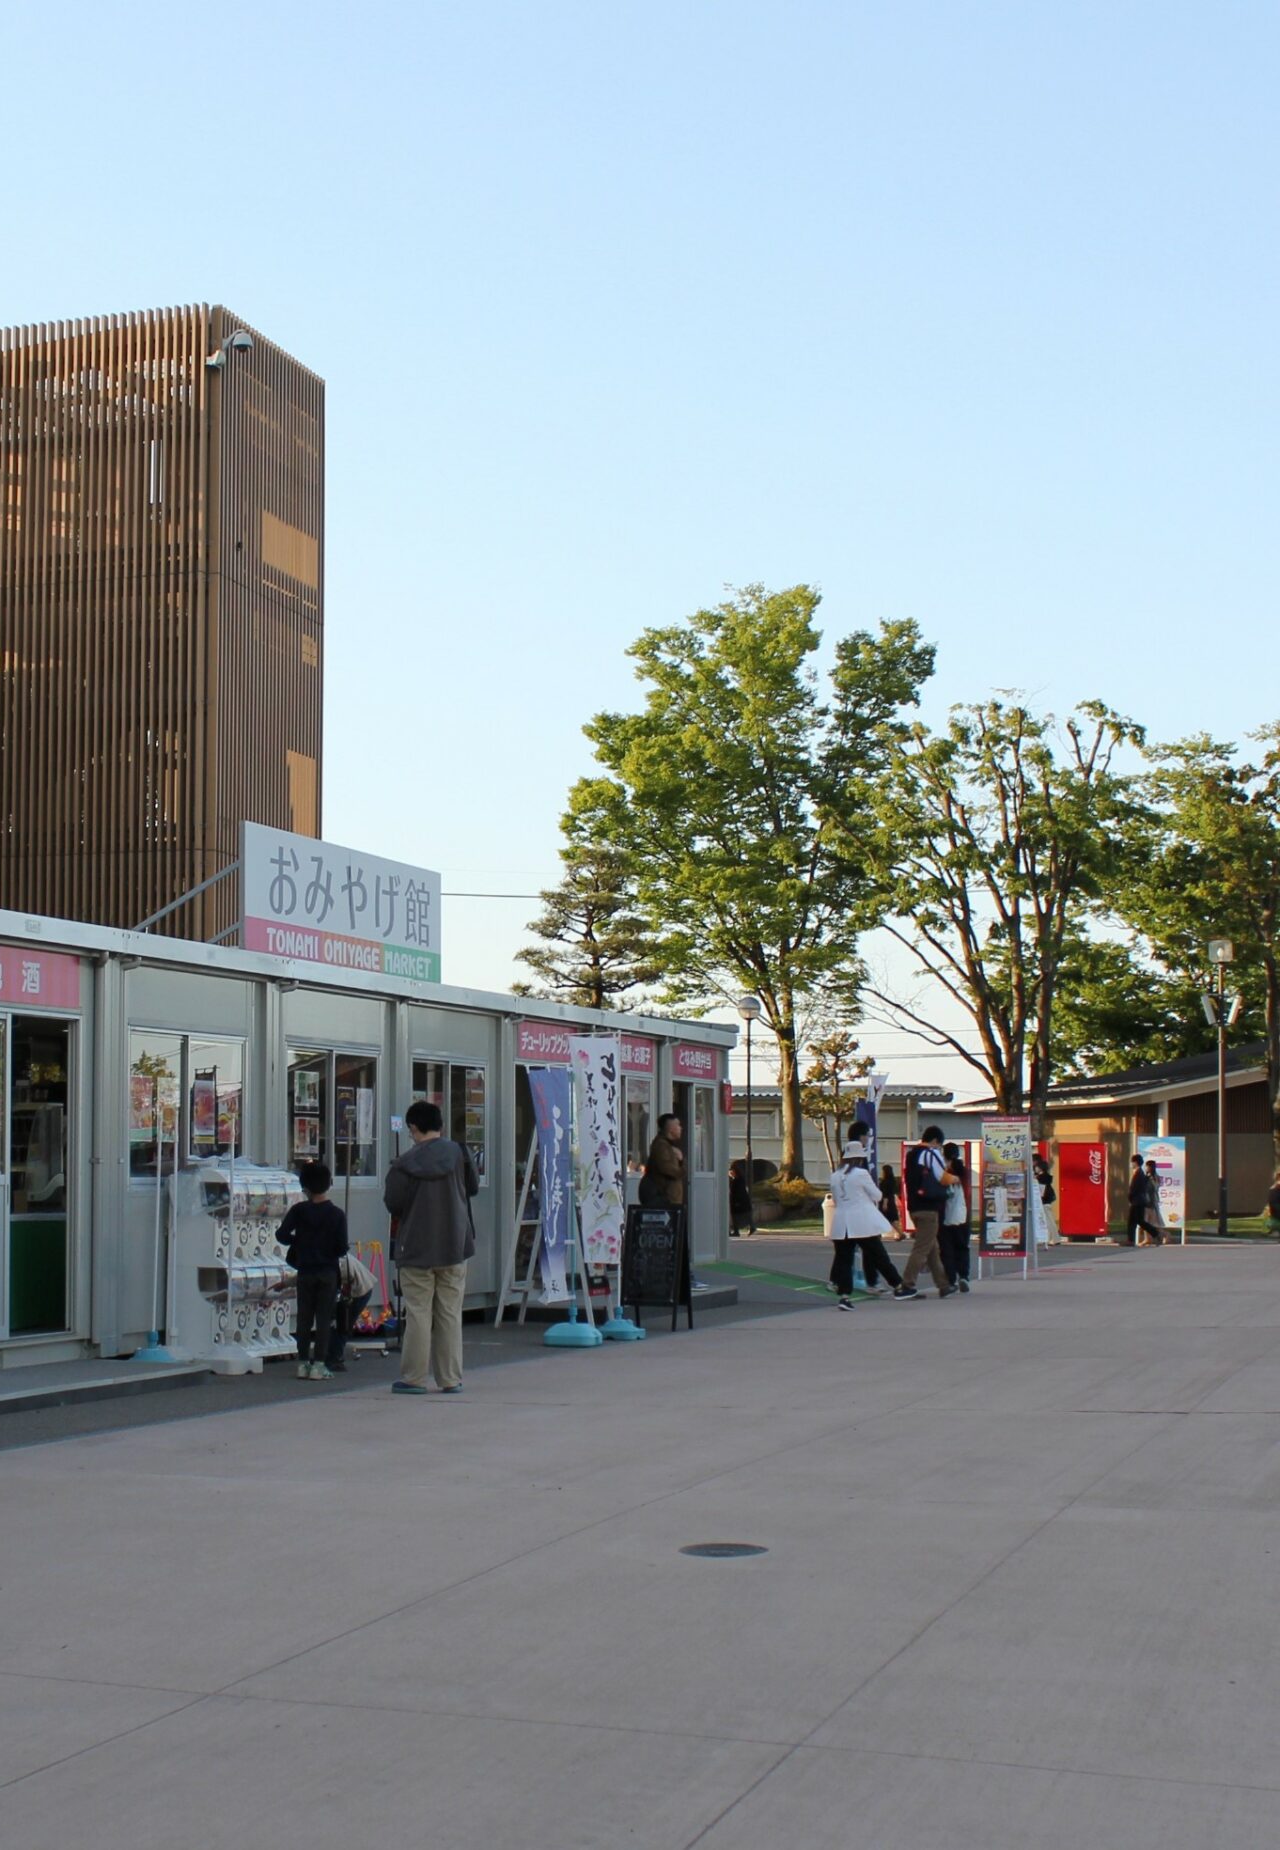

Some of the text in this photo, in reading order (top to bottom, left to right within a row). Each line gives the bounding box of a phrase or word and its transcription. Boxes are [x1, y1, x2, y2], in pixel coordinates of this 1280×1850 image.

[268, 845, 431, 947] おみやげ館
[266, 926, 432, 979] TONAMI OMIYAGE MARKET
[521, 1031, 571, 1055] チューリップグッ
[984, 1133, 1027, 1149] となみ野
[1000, 1147, 1021, 1161] 弁当
[639, 1233, 674, 1248] OPEN
